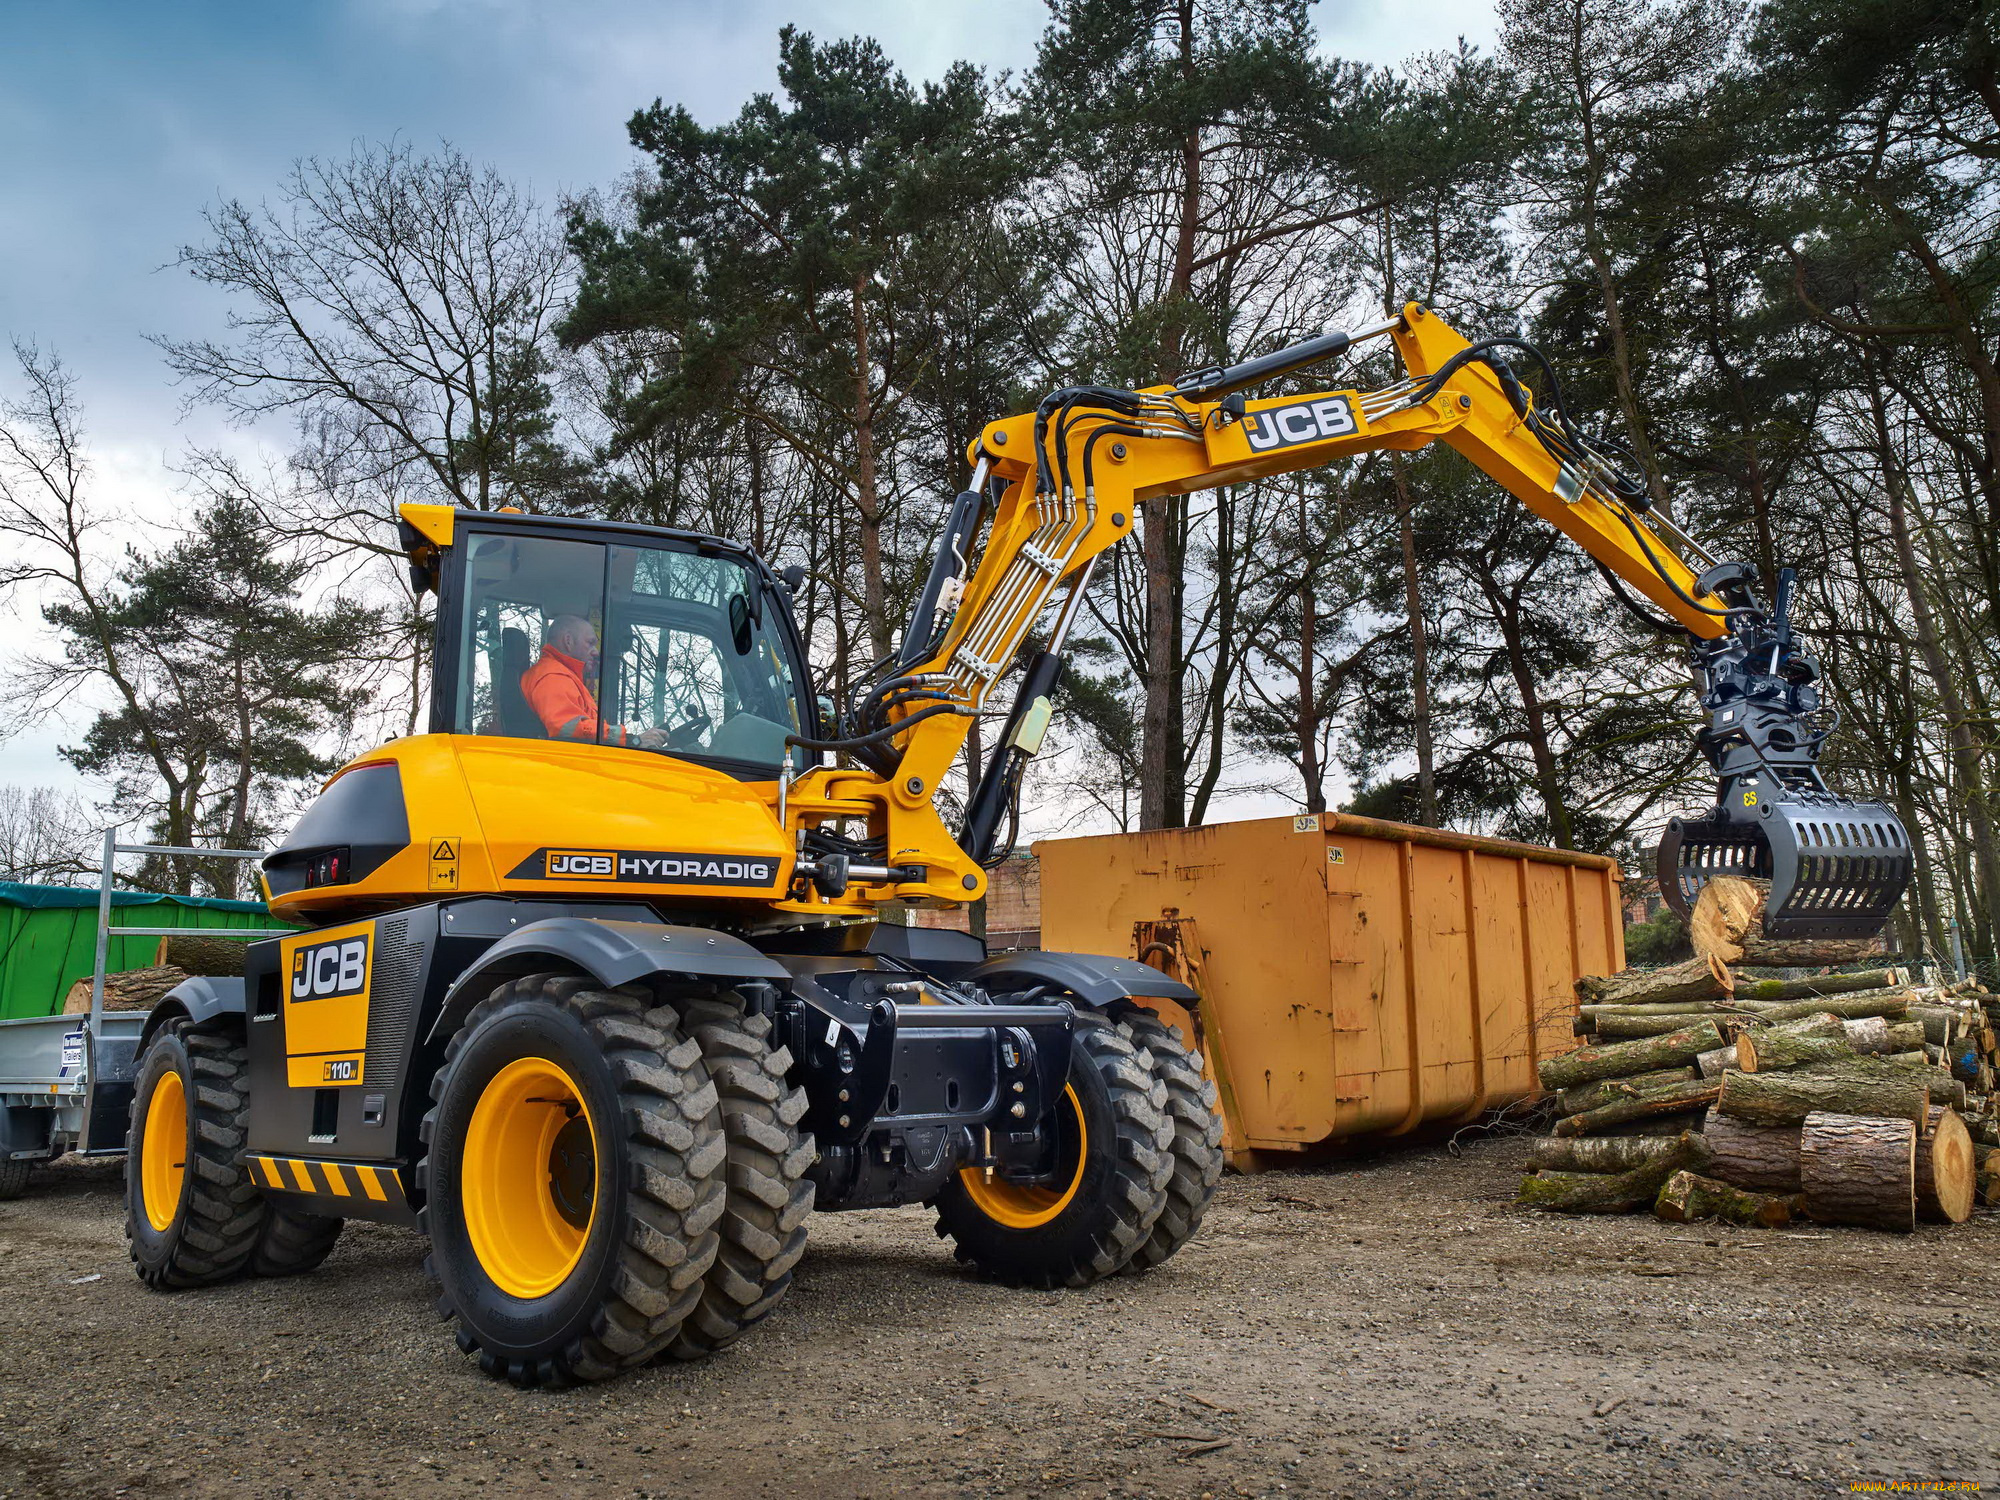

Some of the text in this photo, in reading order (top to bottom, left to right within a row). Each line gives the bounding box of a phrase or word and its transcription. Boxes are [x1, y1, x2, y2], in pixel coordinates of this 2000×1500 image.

[1249, 399, 1353, 448] JCB
[551, 856, 769, 880] JCB HYDRADIG
[292, 940, 366, 998] JCB
